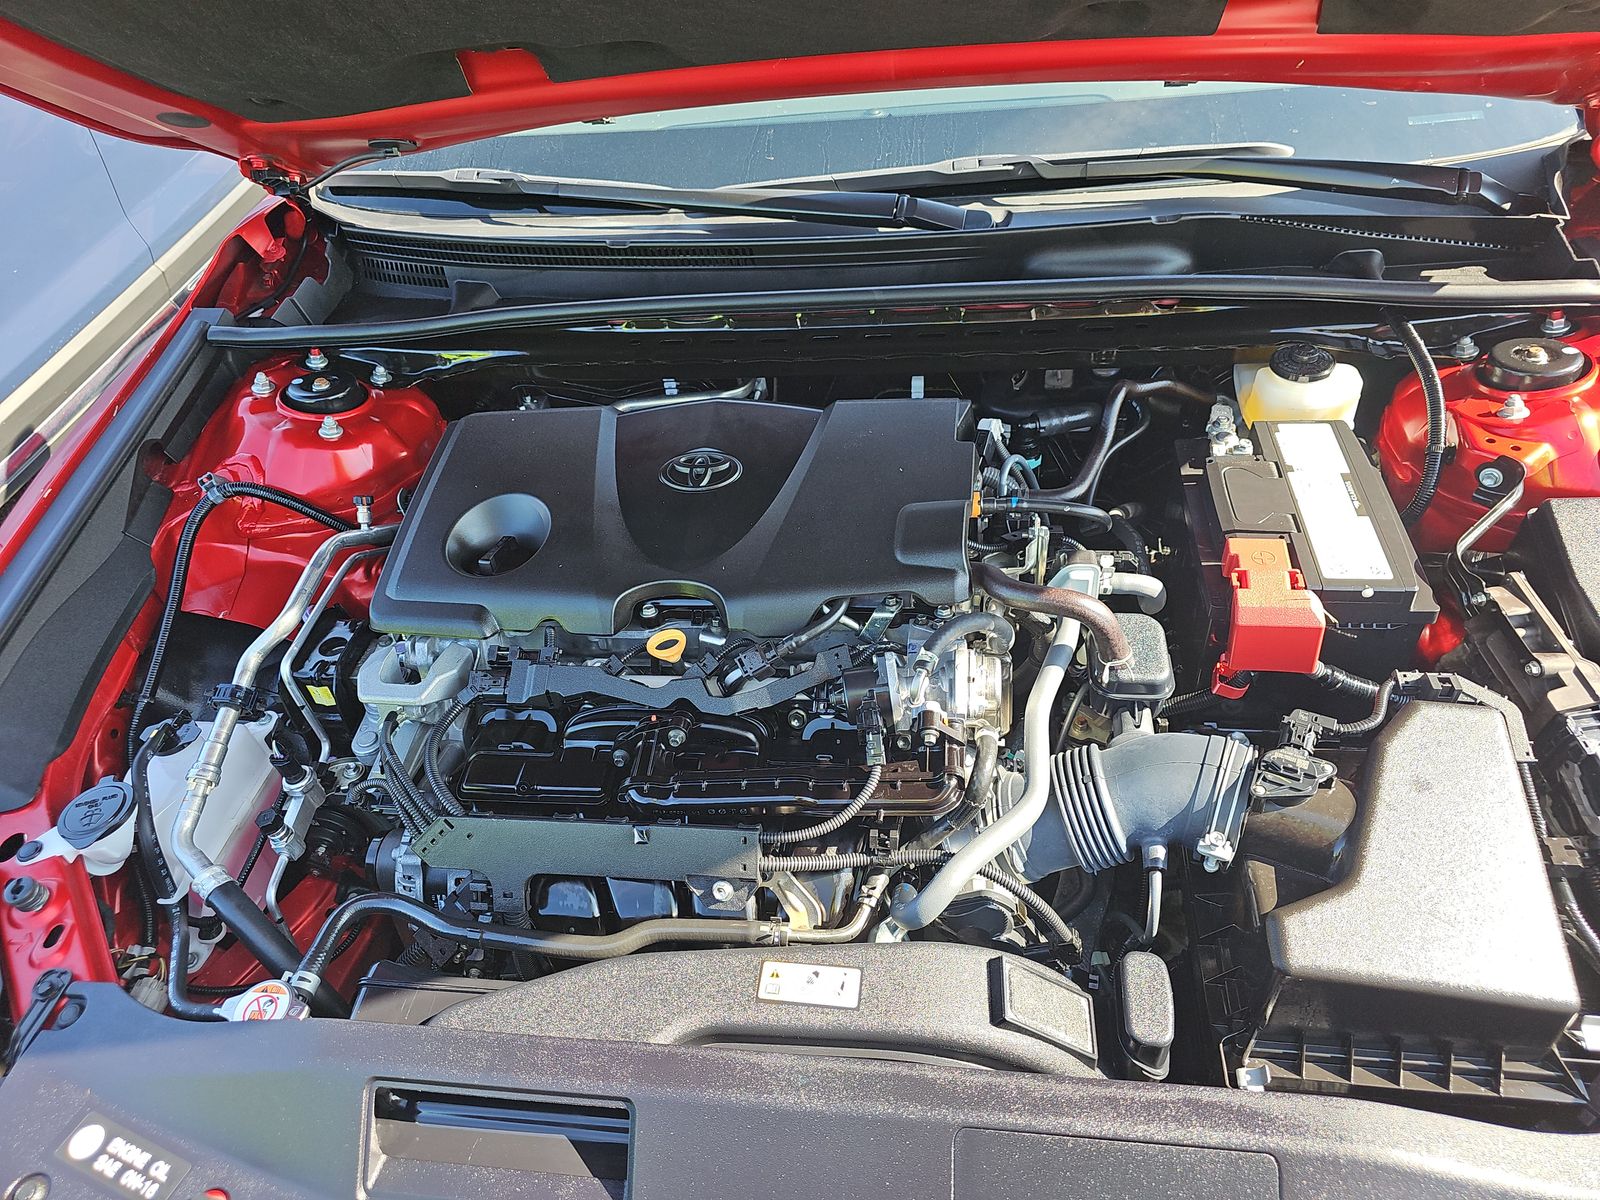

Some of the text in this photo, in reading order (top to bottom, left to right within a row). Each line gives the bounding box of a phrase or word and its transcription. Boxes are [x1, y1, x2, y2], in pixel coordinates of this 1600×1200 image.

[92, 1154, 123, 1179] SAE
[106, 1136, 172, 1183] ENGINE OIL
